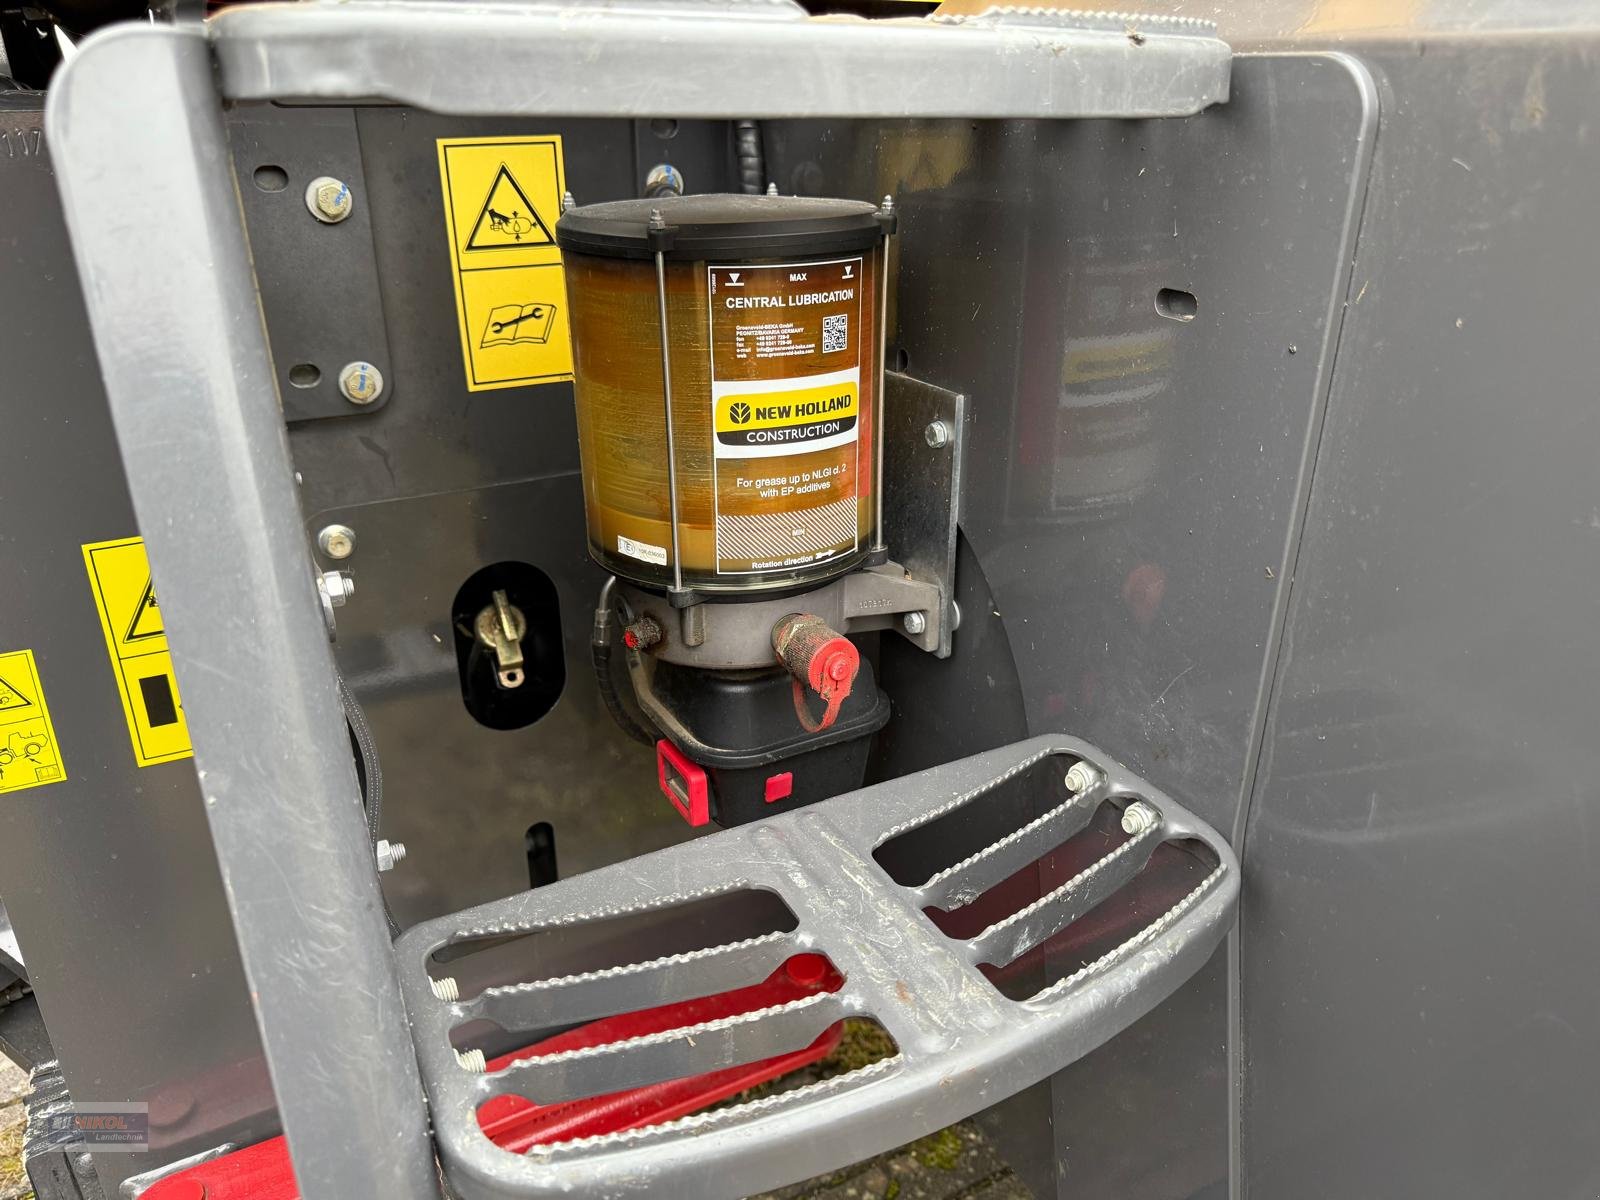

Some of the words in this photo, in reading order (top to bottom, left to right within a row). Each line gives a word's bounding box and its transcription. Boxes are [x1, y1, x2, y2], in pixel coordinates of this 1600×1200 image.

[789, 273, 807, 282] MAX
[726, 296, 786, 309] CENTRAL
[788, 288, 854, 306] LUBRICATION
[755, 405, 792, 420] NEW
[795, 394, 852, 417] HOLLAND
[746, 421, 841, 443] CONSTRUCTION
[736, 478, 753, 488] For
[755, 477, 786, 489] grease
[789, 475, 800, 485] up
[802, 472, 810, 482] to
[812, 467, 832, 479] NLGI
[841, 463, 847, 472] 2
[760, 488, 779, 498] with
[781, 487, 794, 496] EP
[796, 480, 831, 494] additives
[751, 561, 783, 569] Rotation
[783, 555, 814, 566] direction
